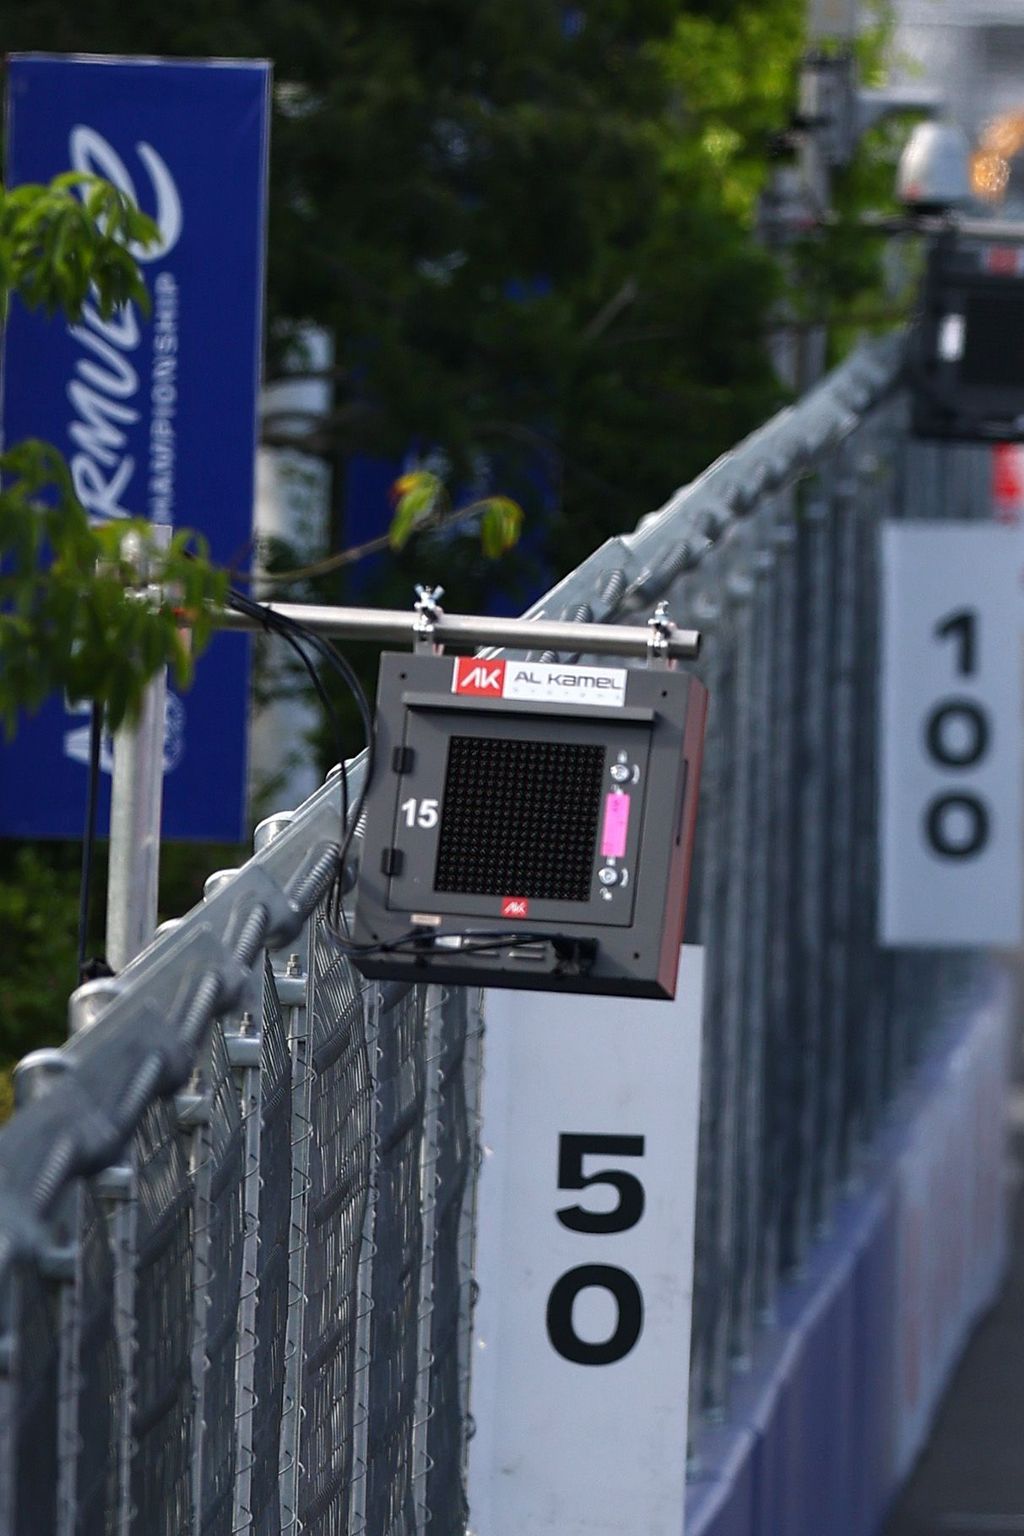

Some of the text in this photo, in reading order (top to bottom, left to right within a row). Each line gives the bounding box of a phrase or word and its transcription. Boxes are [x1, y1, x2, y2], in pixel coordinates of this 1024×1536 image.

[149, 271, 180, 526] HAMPIONSHIP
[514, 671, 541, 684] AL
[401, 799, 438, 829] 15
